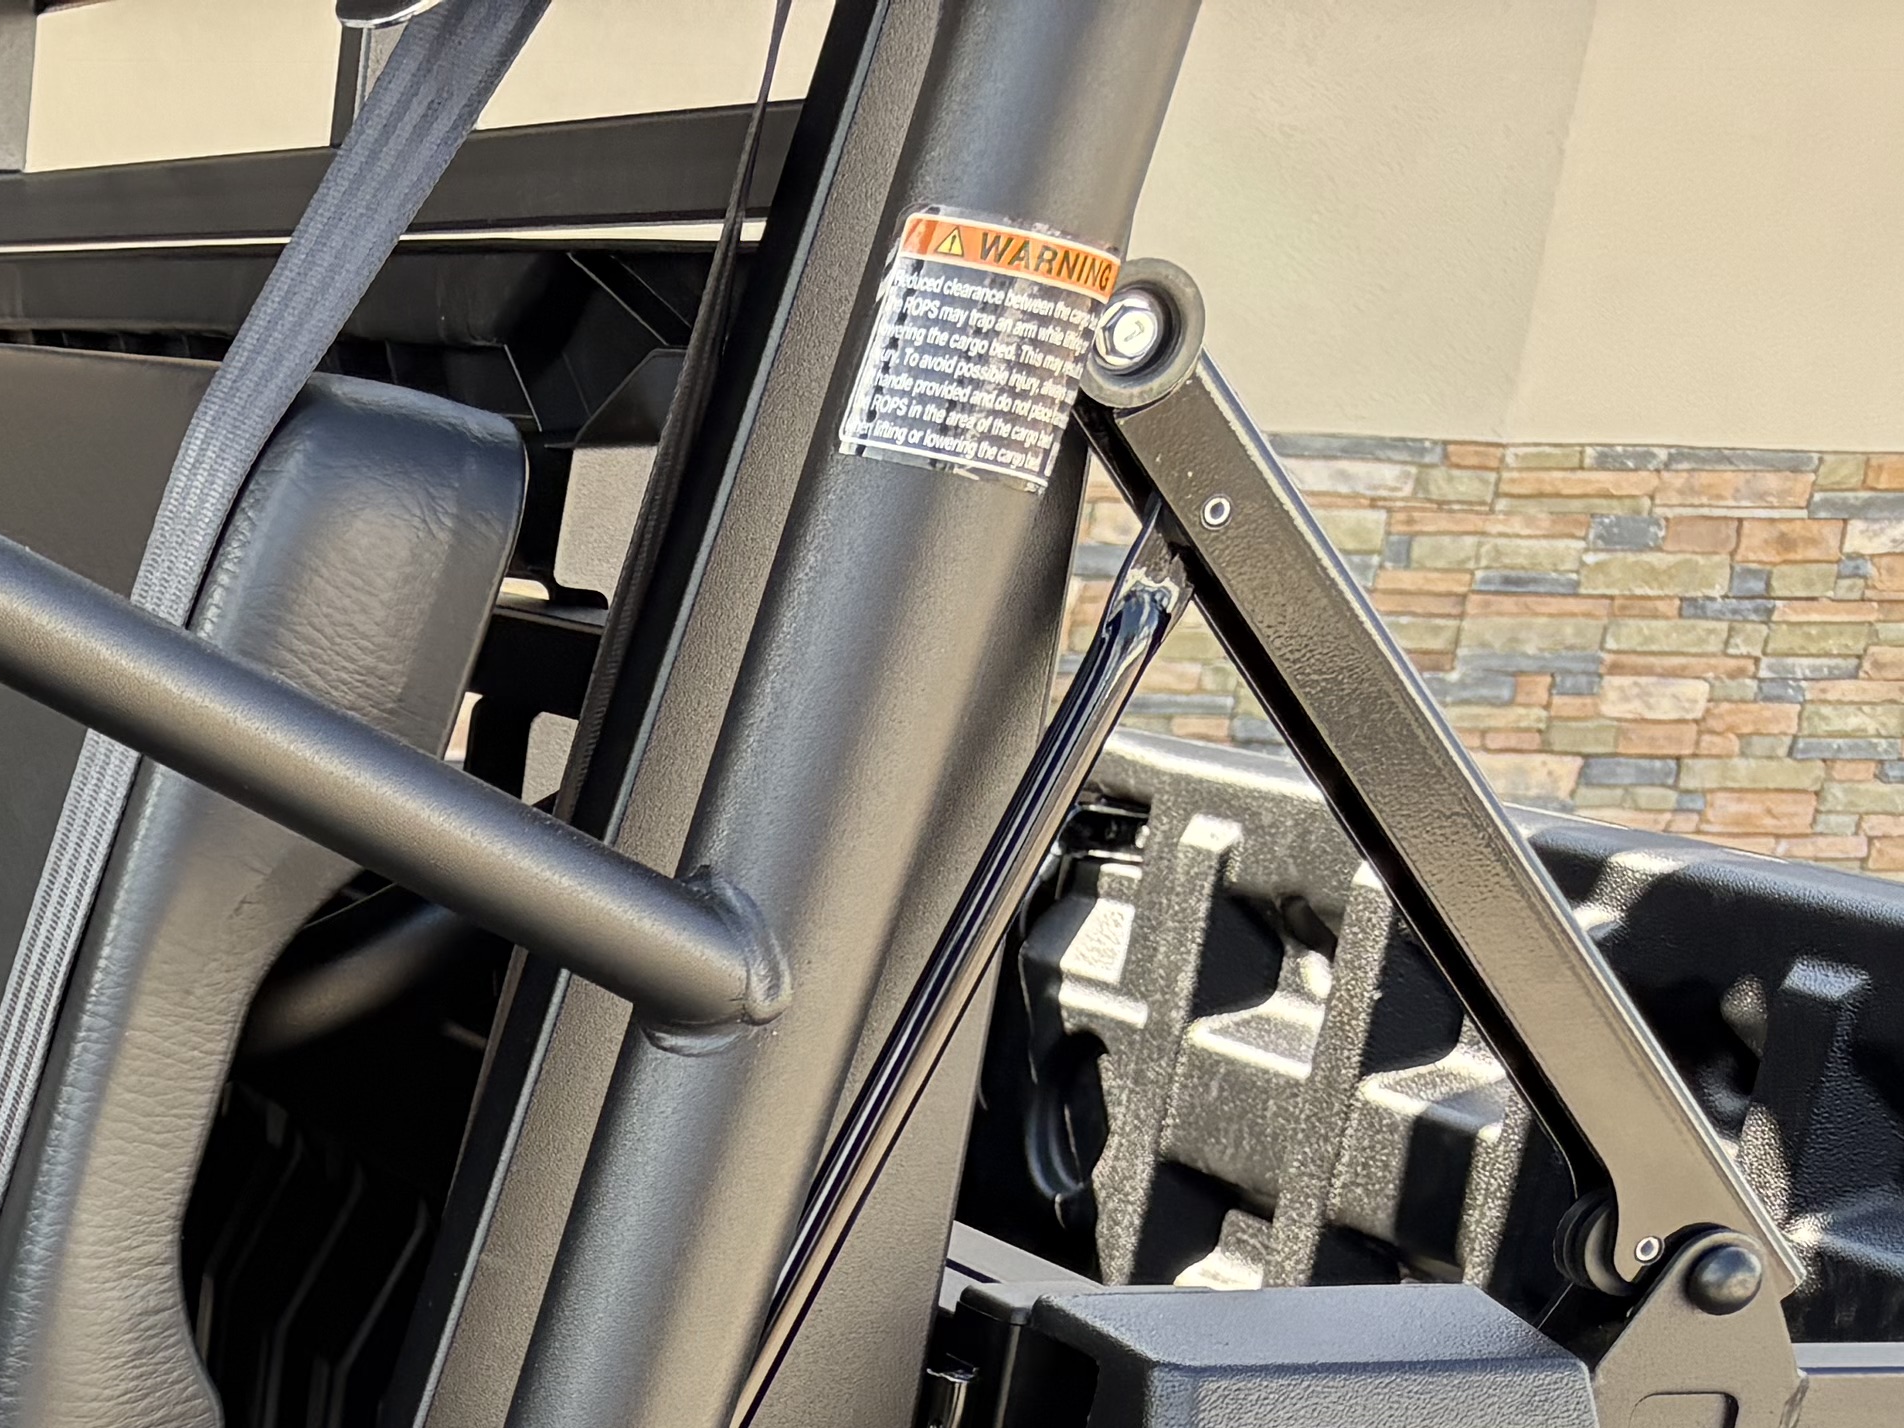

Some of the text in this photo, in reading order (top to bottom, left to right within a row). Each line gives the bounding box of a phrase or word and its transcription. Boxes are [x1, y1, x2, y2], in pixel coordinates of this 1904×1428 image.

[979, 231, 1113, 292] WARNING
[893, 266, 944, 293] Reduced
[942, 278, 1005, 304] clearance
[1003, 289, 1054, 316] between
[1053, 300, 1071, 321] the
[902, 295, 940, 318] ROPS
[938, 305, 969, 327] may
[968, 309, 995, 331] trap
[994, 316, 1013, 333] an
[1011, 320, 1037, 338] arm
[1037, 326, 1064, 345] while
[903, 346, 919, 366] To
[918, 353, 957, 373] avoid
[953, 358, 1009, 388] possible
[1007, 369, 1040, 395] injury,
[926, 326, 948, 343] the
[948, 333, 989, 355] cargo
[988, 339, 1016, 360] bed.
[1019, 345, 1043, 366] This
[1042, 354, 1063, 376] may
[873, 367, 913, 391] handle
[911, 378, 971, 402] provided
[969, 390, 996, 408] and
[994, 394, 1012, 411] do
[1011, 399, 1032, 416] not
[870, 393, 908, 416] ROPS
[907, 399, 923, 418] in
[922, 403, 945, 423] the
[945, 410, 977, 431] area
[974, 415, 992, 432] of
[990, 418, 1011, 437] the
[1010, 425, 1038, 447] cargo
[872, 416, 907, 444] lifting
[907, 428, 923, 443] or
[922, 428, 978, 461] lowering
[977, 441, 997, 460] the
[996, 447, 1025, 468] cargo
